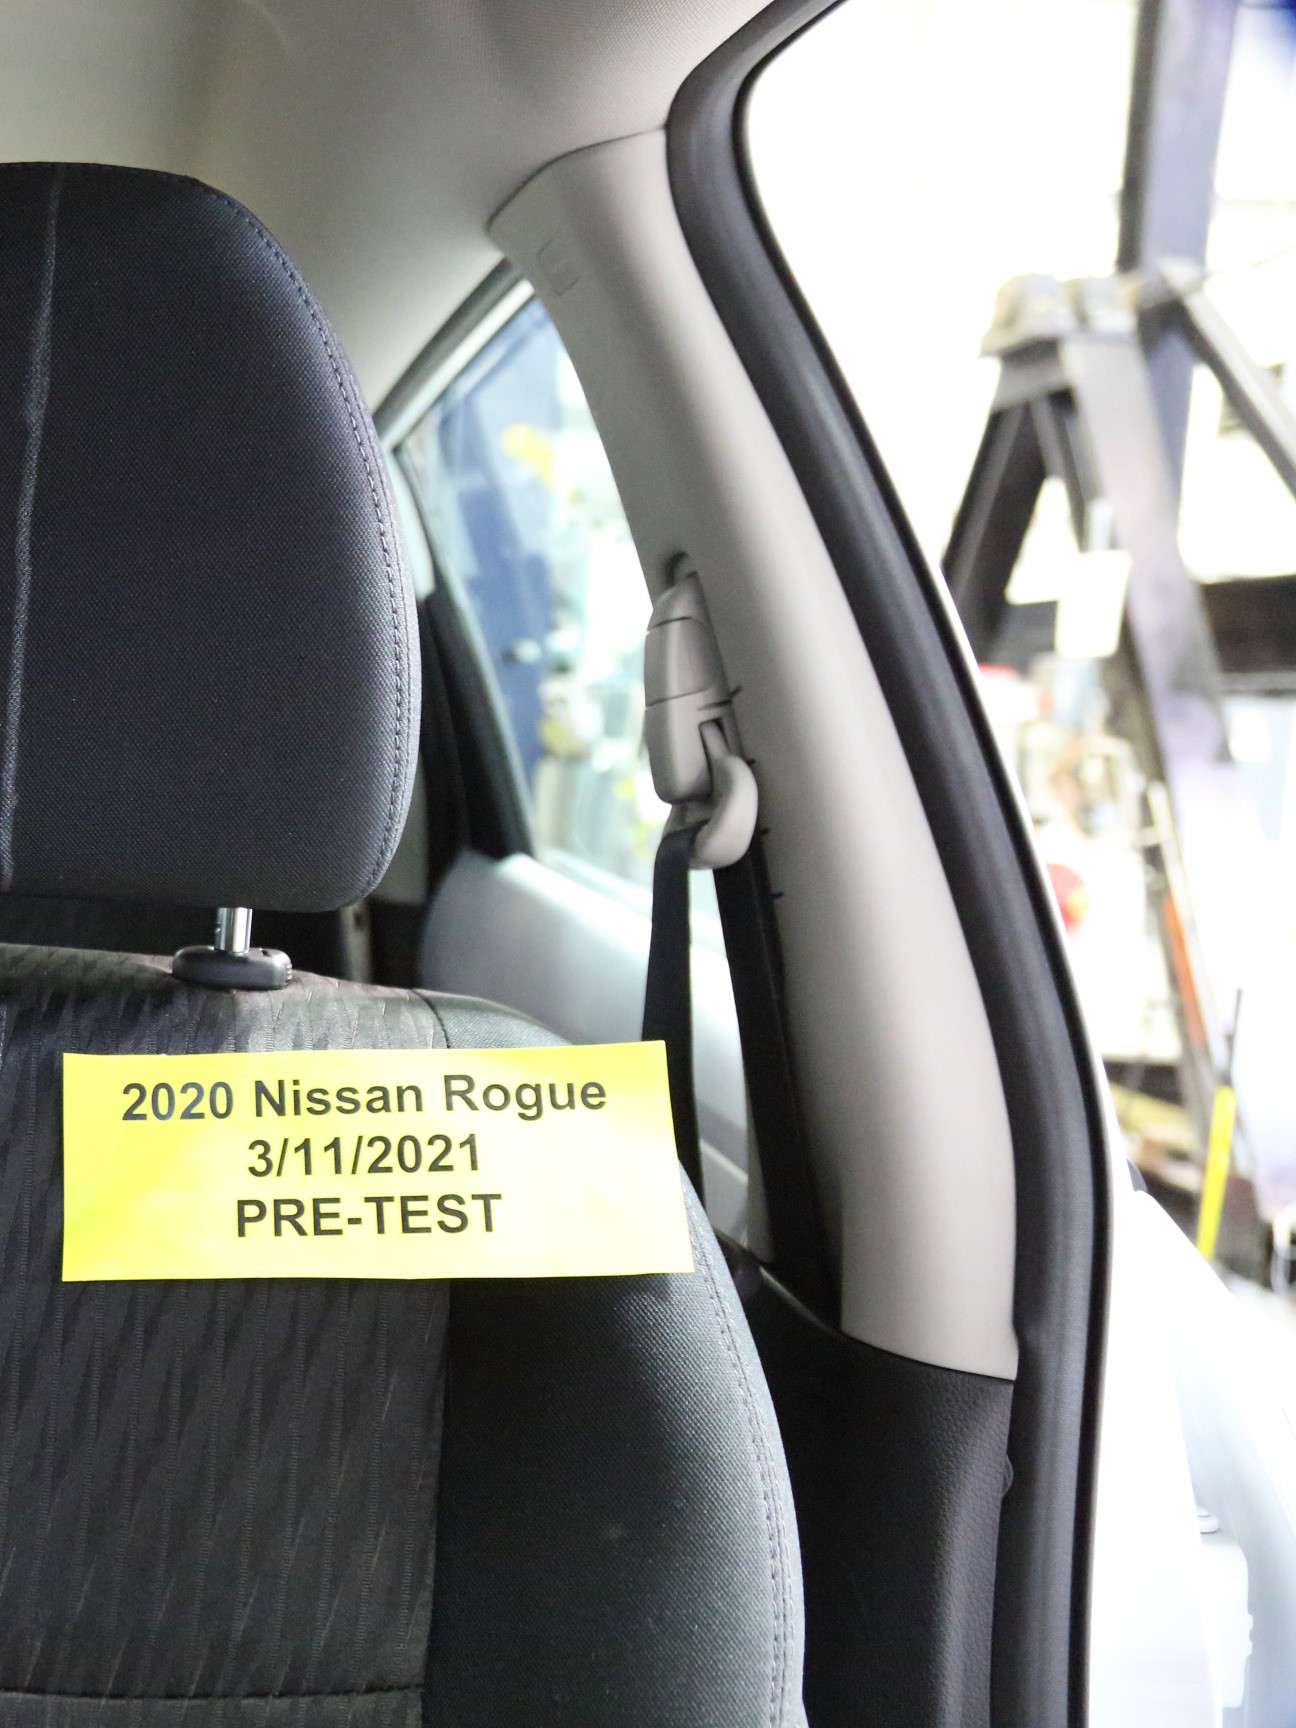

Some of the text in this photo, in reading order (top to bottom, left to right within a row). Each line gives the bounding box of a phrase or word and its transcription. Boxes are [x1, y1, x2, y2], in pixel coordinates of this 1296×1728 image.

[121, 1074, 607, 1121] 2020 Nissan Rogue
[247, 1134, 479, 1178] 3/11/2021
[236, 1194, 503, 1239] PRE-TEST
